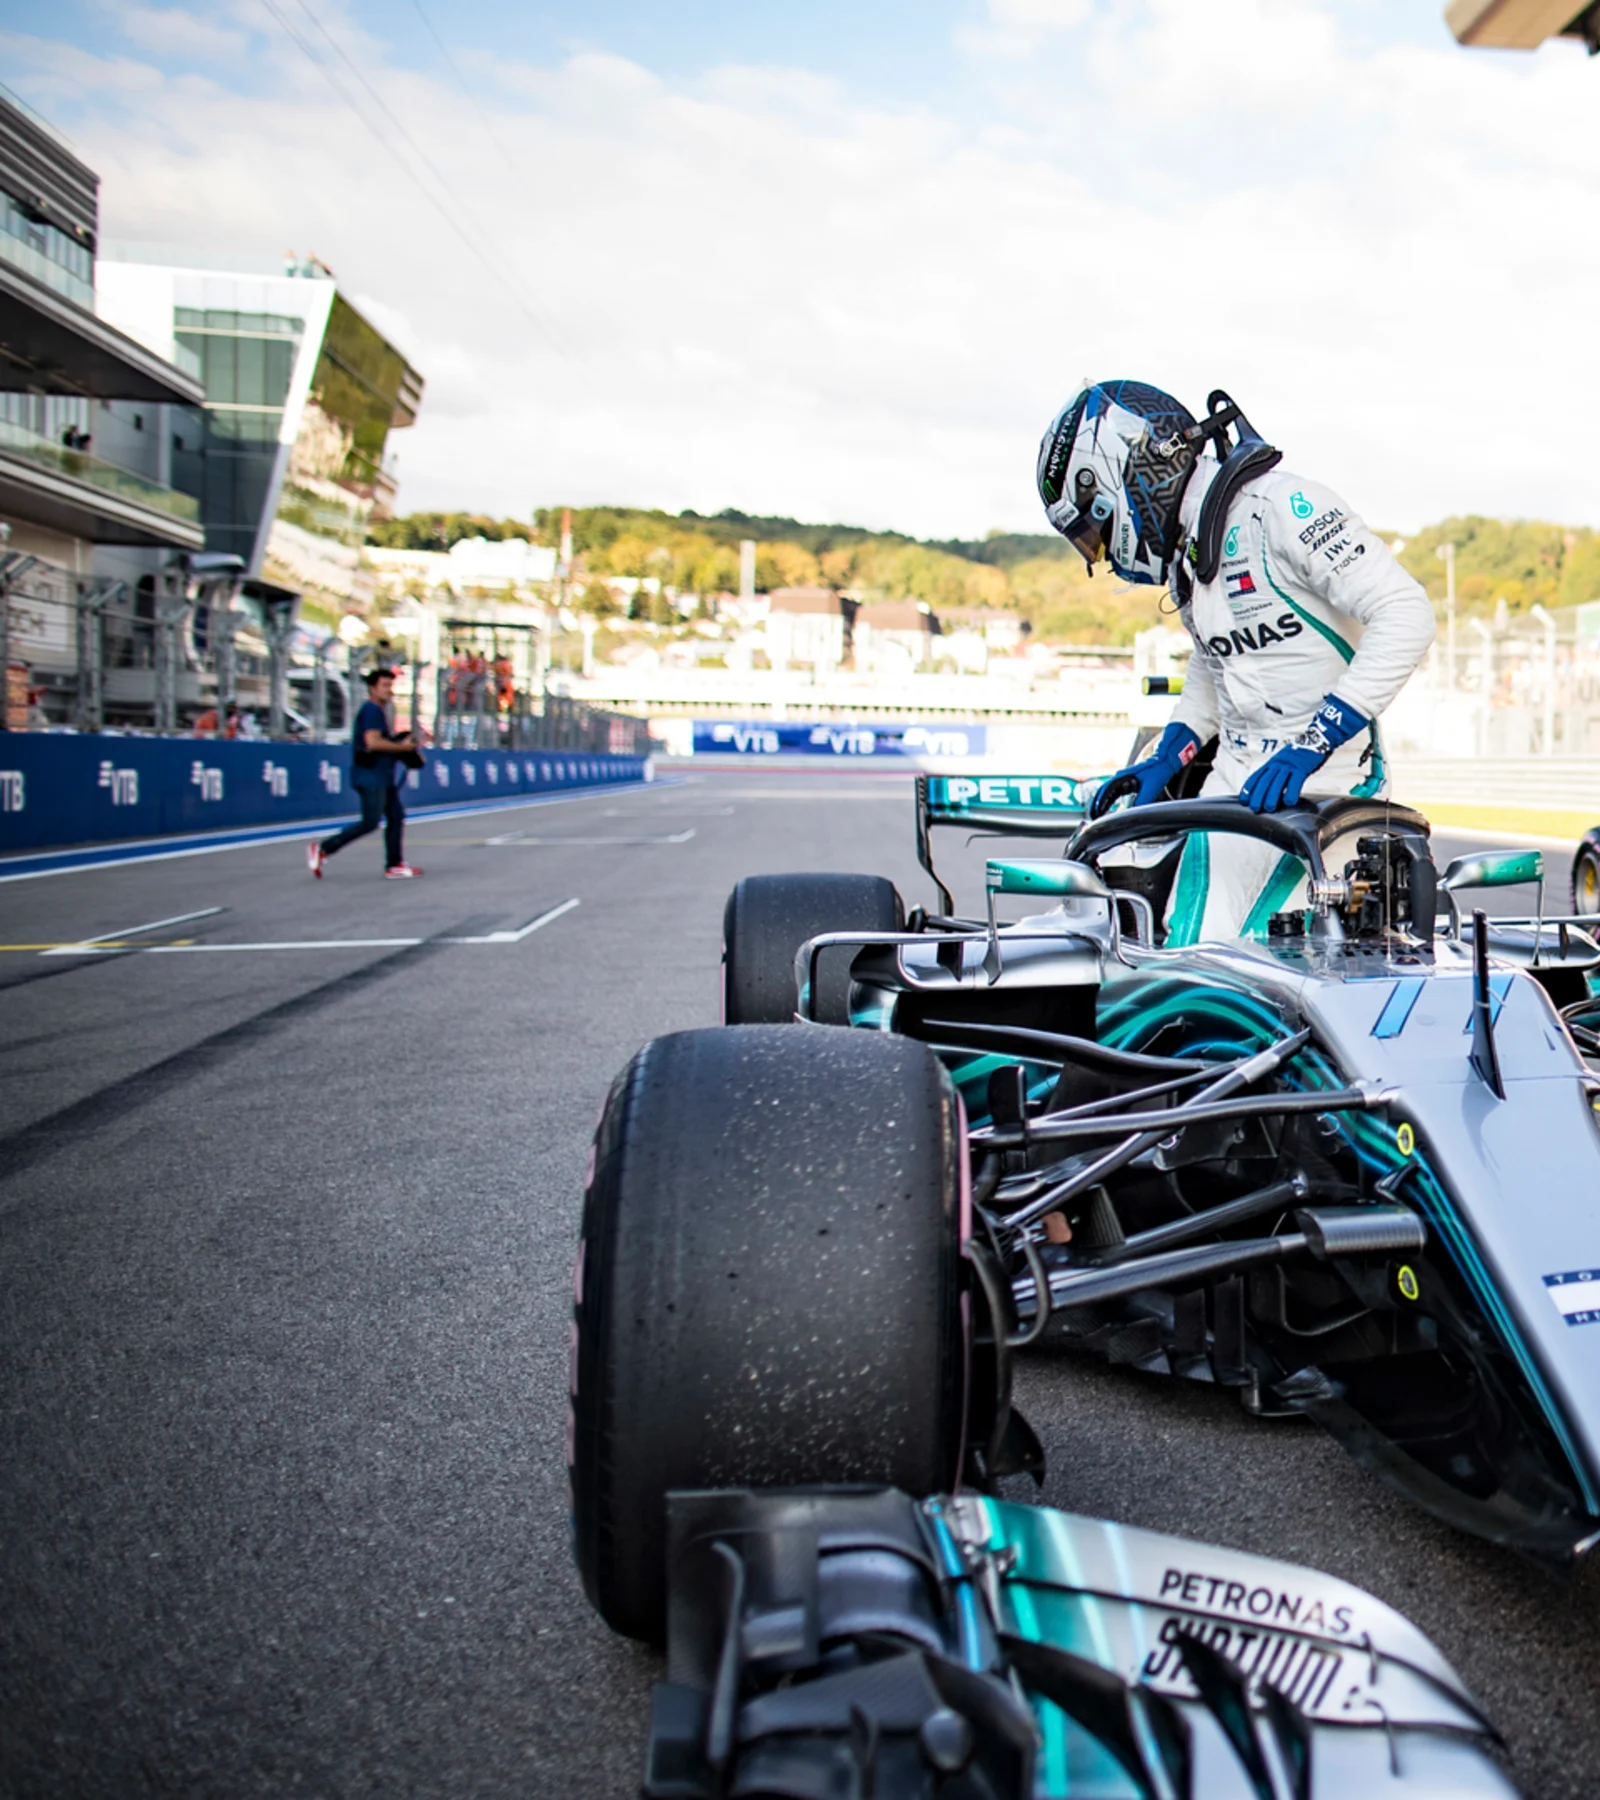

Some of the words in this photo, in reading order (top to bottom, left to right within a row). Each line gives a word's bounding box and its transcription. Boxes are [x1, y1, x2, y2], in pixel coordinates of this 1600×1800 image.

[1298, 507, 1344, 546] EPSON
[1204, 612, 1303, 658] ONAS
[733, 729, 781, 753] VTB
[0, 770, 24, 812] TB
[111, 768, 138, 805] VTB
[1159, 1567, 1355, 1635] PETRONAS
